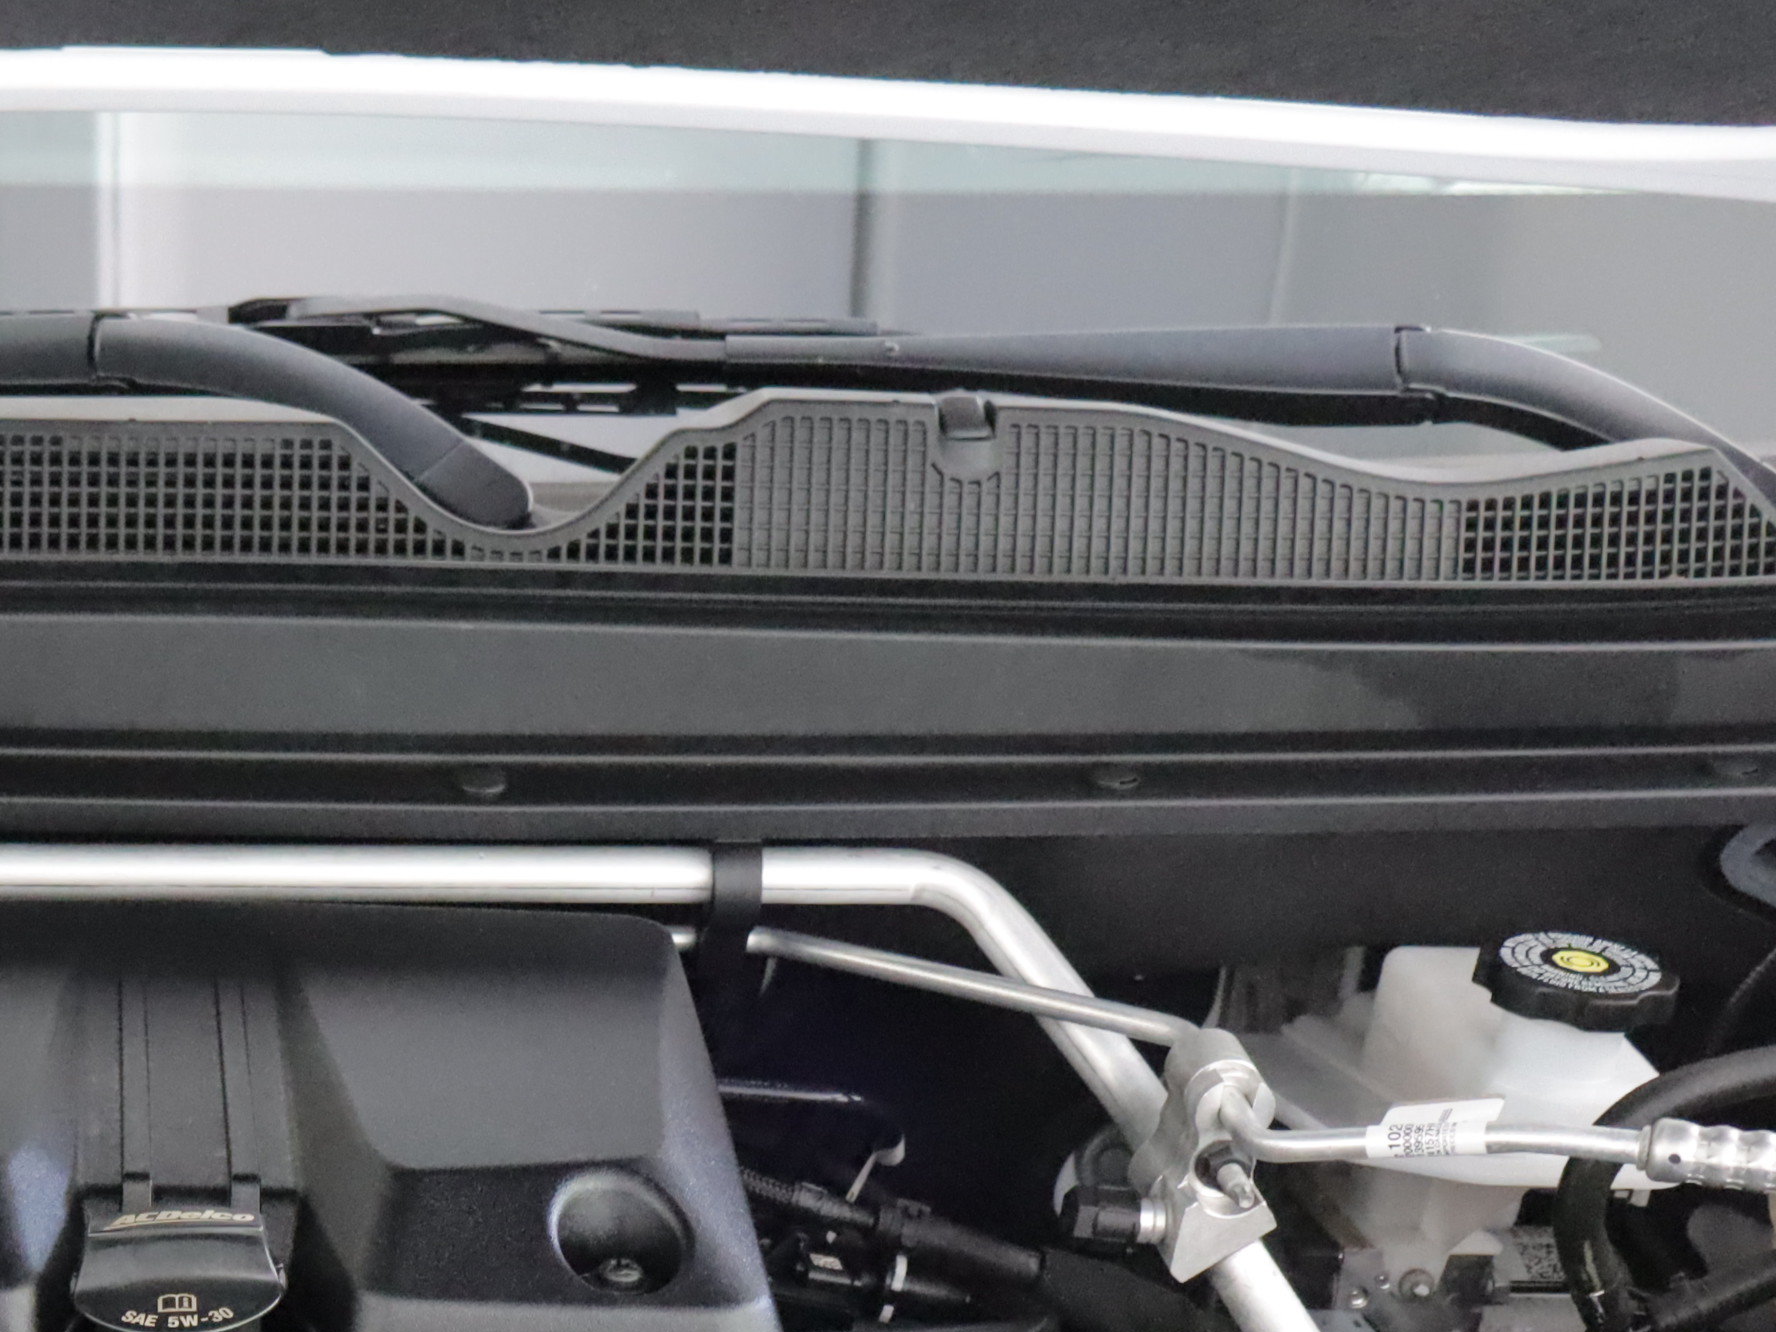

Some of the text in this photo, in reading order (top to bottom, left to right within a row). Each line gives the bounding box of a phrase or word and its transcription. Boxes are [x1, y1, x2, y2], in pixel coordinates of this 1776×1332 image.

[106, 1209, 256, 1228] ACDelco
[121, 1307, 234, 1328] SAE 5W-30
